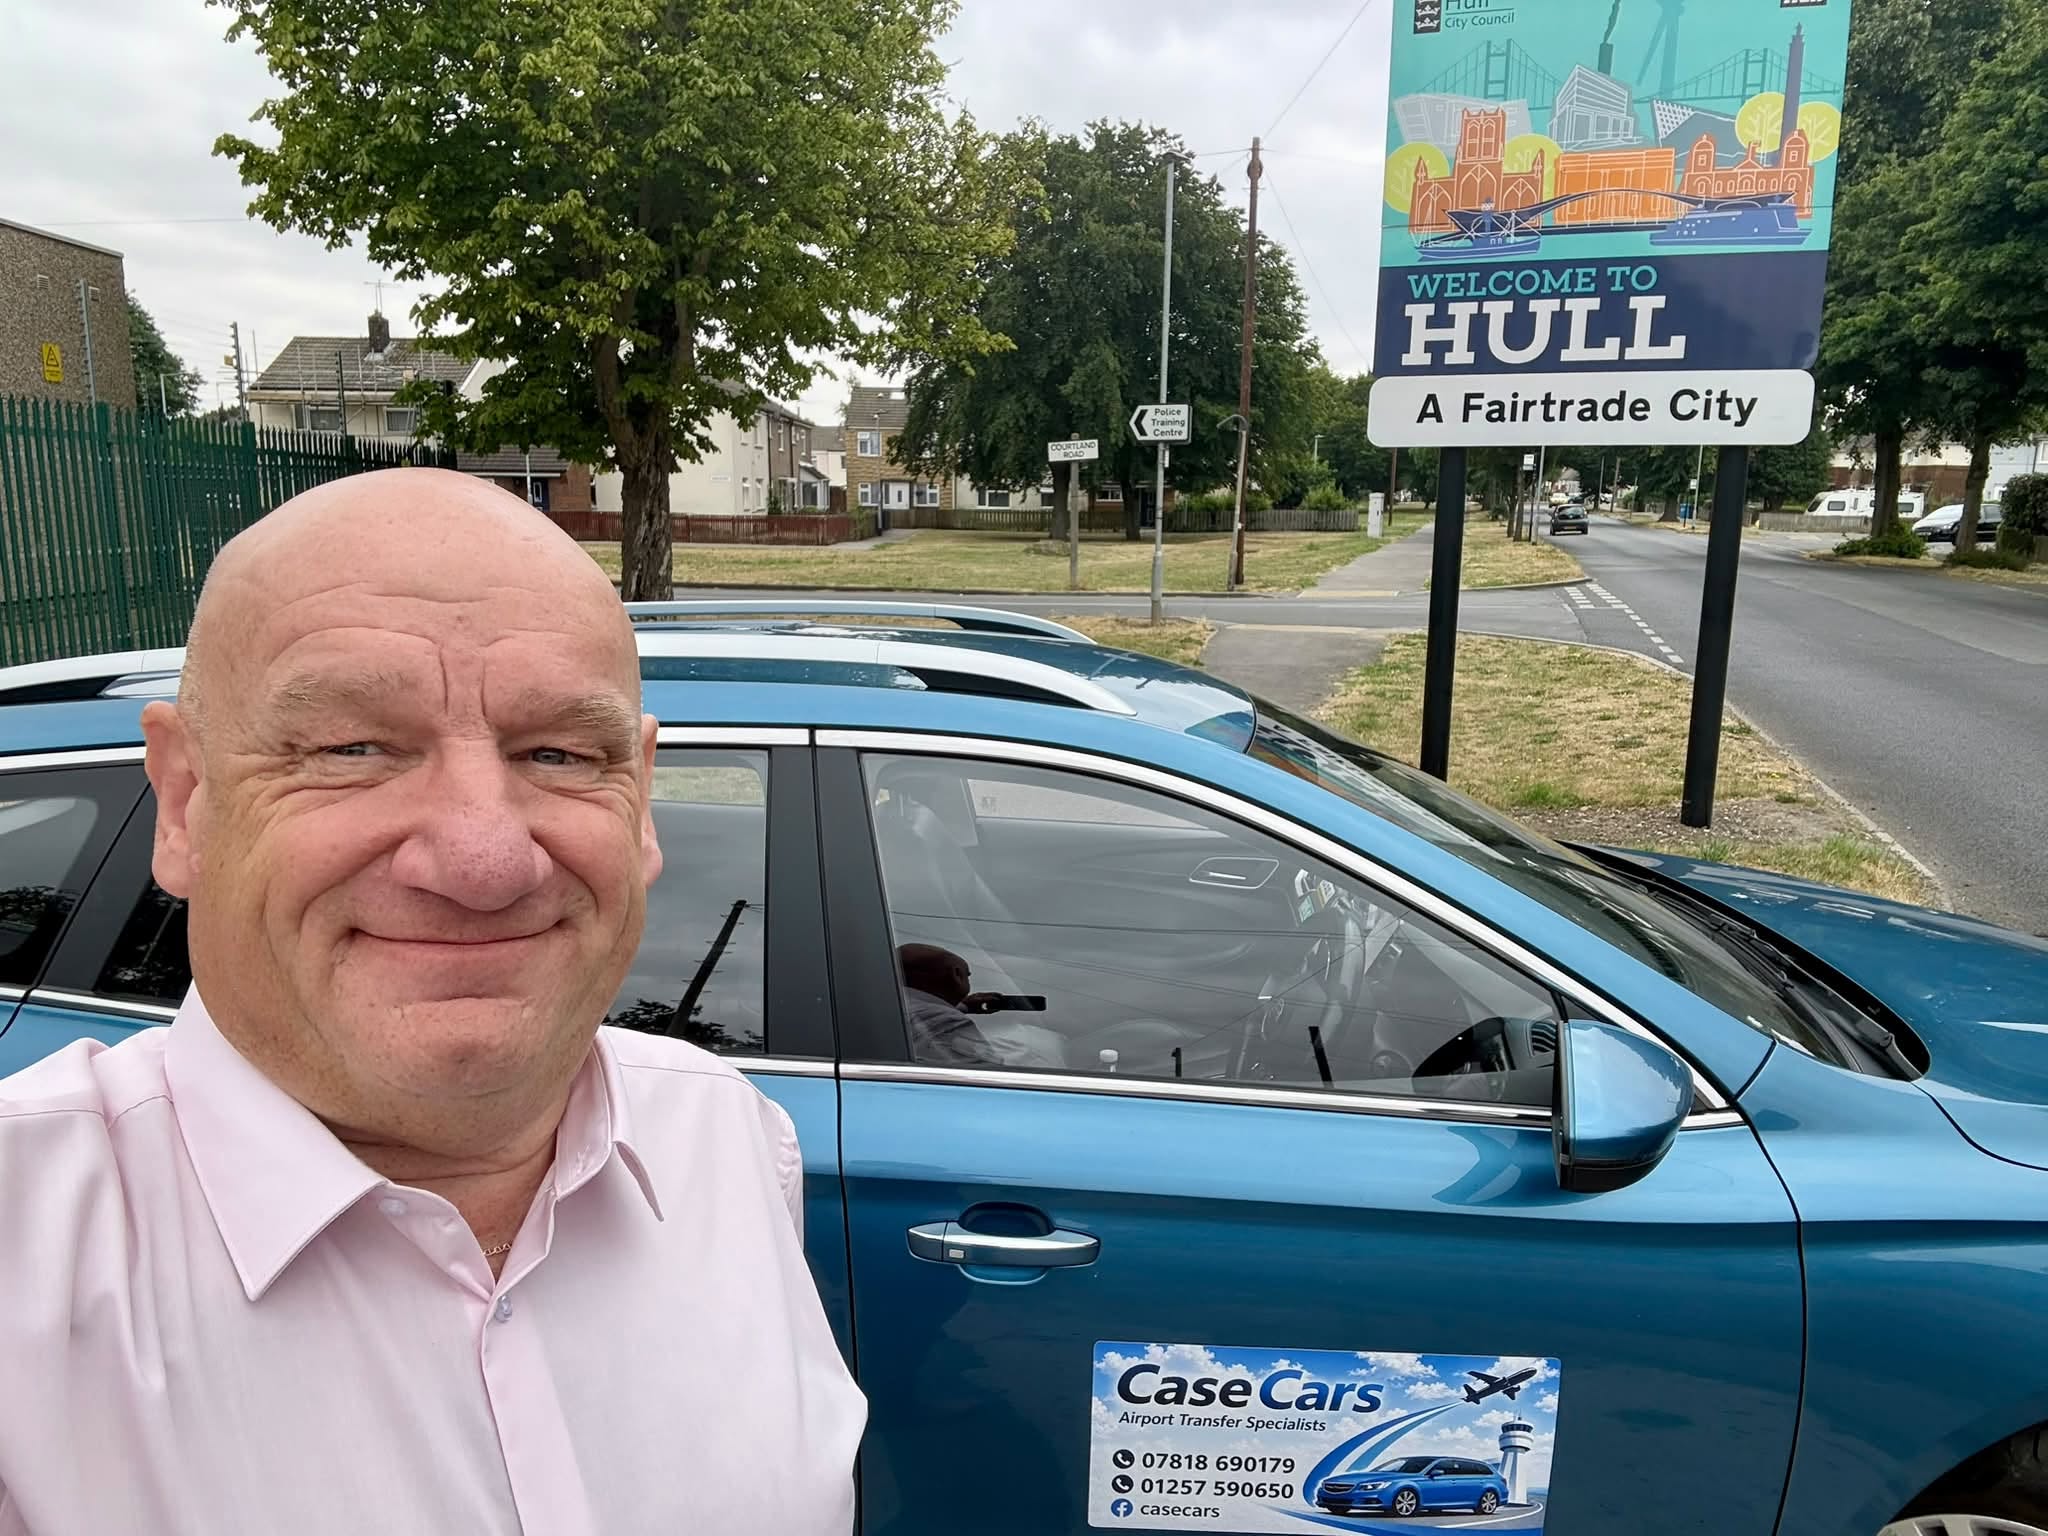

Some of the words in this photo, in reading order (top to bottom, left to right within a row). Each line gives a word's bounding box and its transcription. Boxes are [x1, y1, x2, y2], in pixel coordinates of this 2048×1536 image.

[1445, 17, 1467, 30] City
[1471, 12, 1514, 26] Council
[1408, 267, 1597, 298] WELCOME
[1607, 265, 1658, 292] TO
[1401, 295, 1686, 366] HULL
[1154, 408, 1181, 416] Police
[1416, 393, 1444, 423] A
[1462, 390, 1650, 423] Fairtrade
[1669, 388, 1759, 427] City
[1151, 418, 1185, 427] Training
[1153, 428, 1183, 437] Centre
[1050, 442, 1096, 451] COURTLAND
[1117, 1363, 1252, 1408] Case
[1259, 1369, 1384, 1413] Cars
[1119, 1411, 1175, 1428] Airport
[1179, 1413, 1243, 1428] Transfer
[1246, 1416, 1326, 1432] Specialists
[1142, 1453, 1208, 1470] 07818
[1215, 1456, 1295, 1473] 690179
[1141, 1478, 1207, 1495] 01257
[1213, 1481, 1294, 1499] 590650
[1140, 1504, 1220, 1518] casecars
